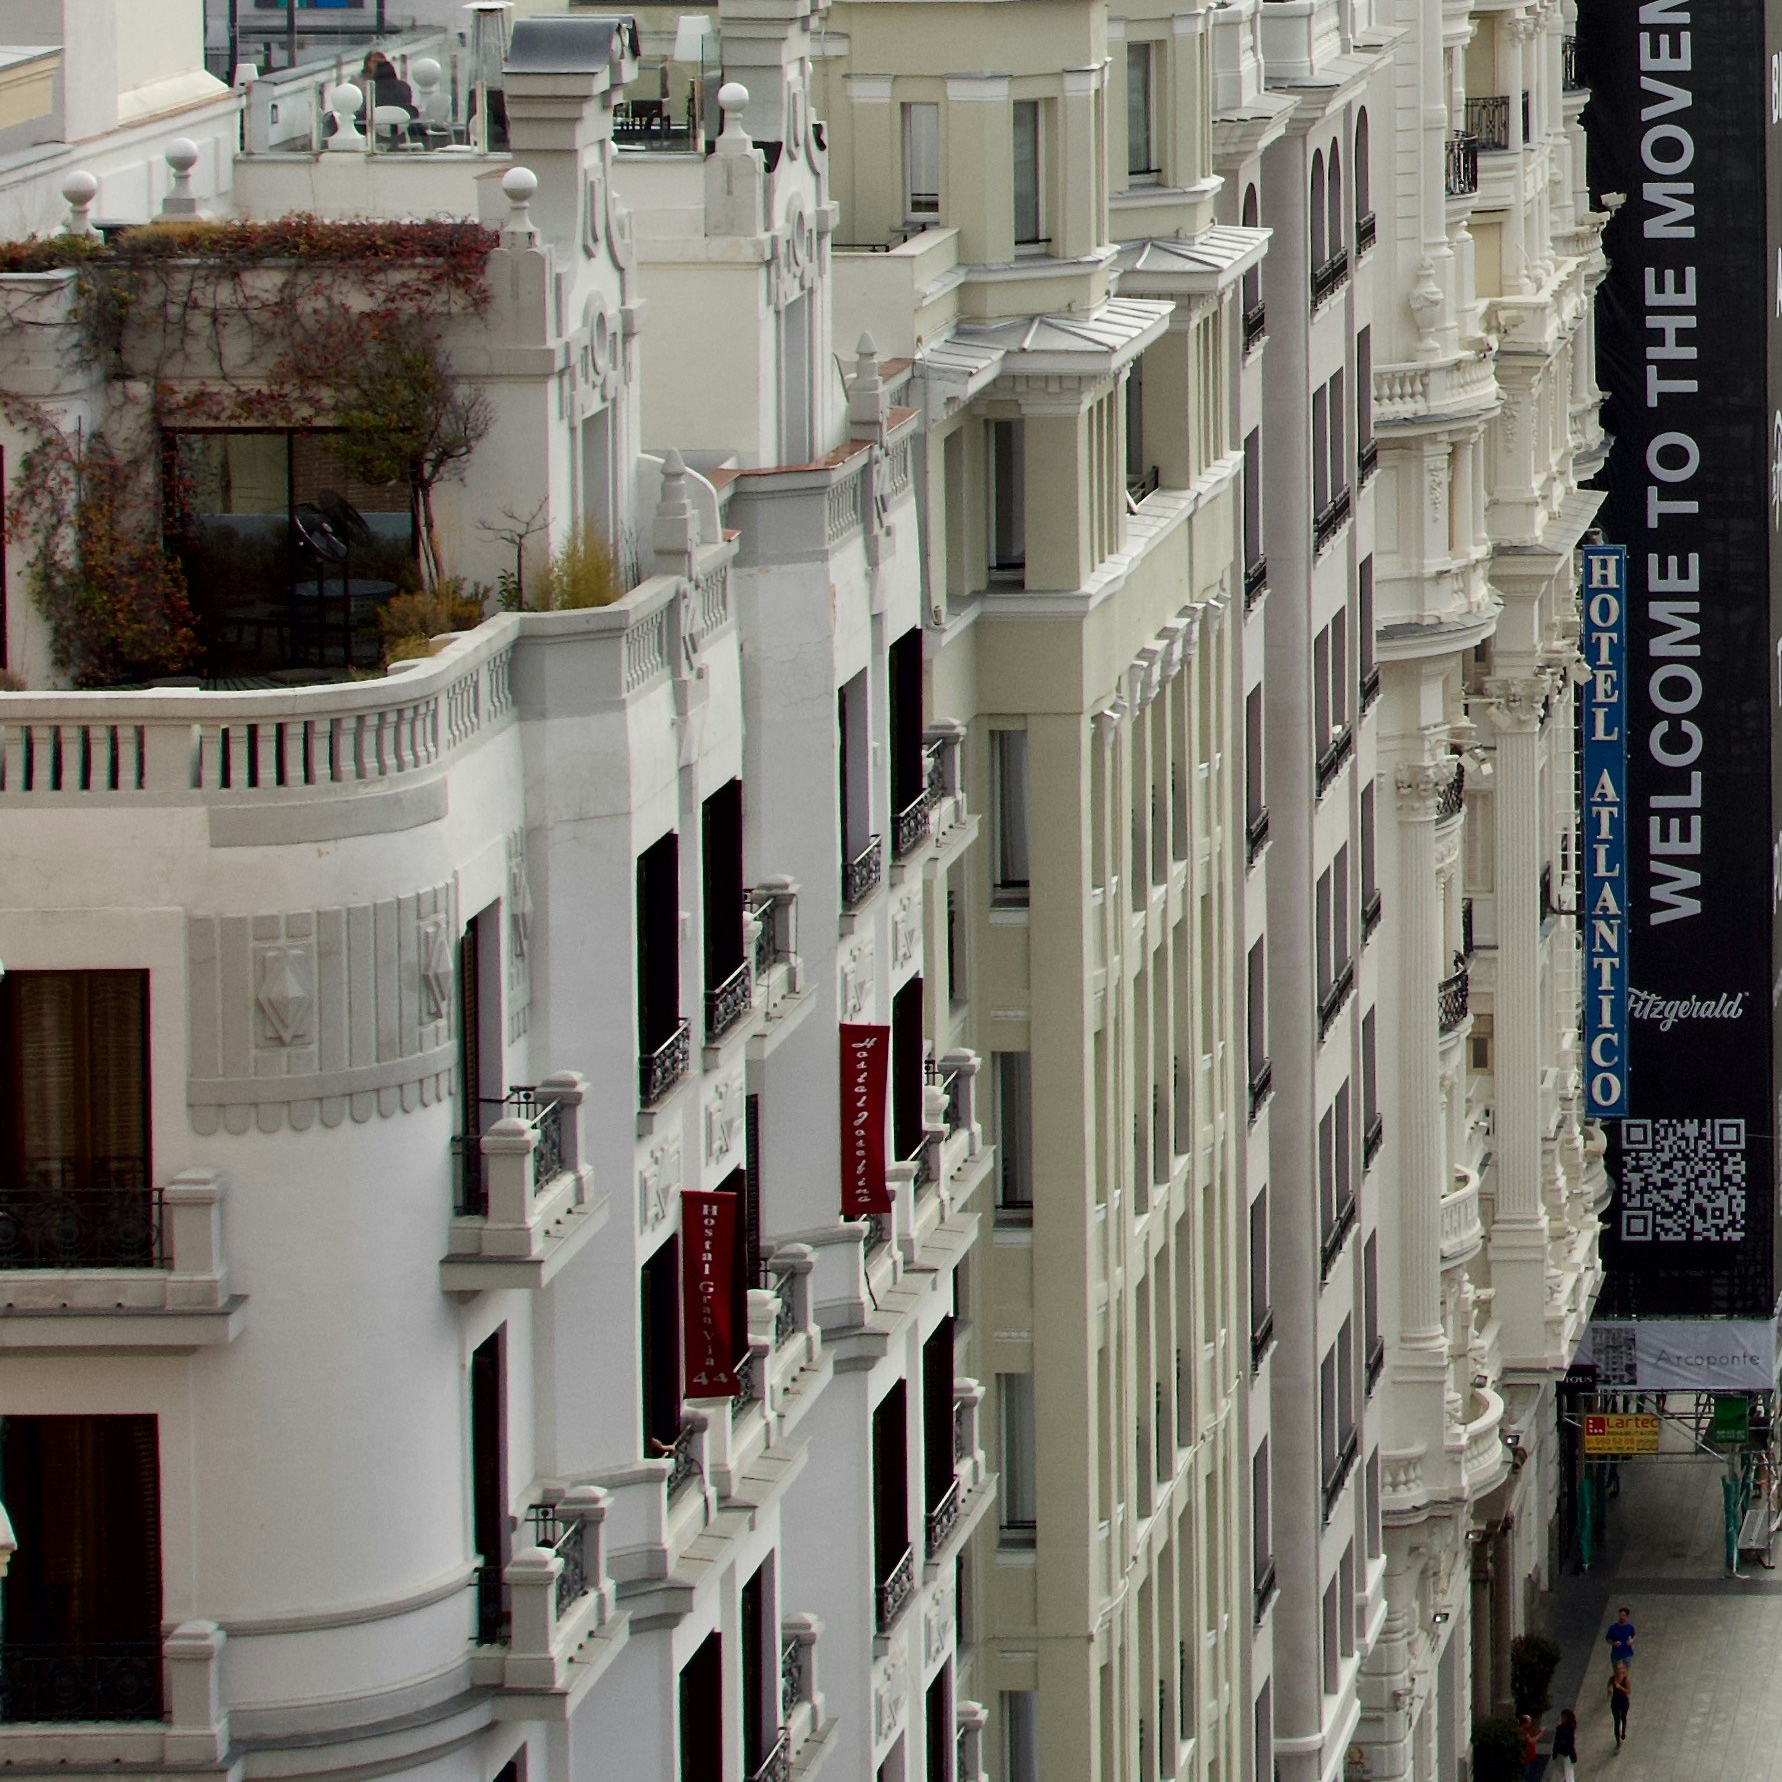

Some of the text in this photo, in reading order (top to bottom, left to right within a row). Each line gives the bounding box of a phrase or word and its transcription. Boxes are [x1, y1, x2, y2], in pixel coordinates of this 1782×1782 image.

[1645, 266, 1698, 407] THE
[1646, 431, 1699, 528] TO
[1649, 553, 1702, 925] WELCOME
[1589, 555, 1622, 1106] HOTEL ATLANTICO
[1628, 987, 1744, 1032] Fitzgerald
[851, 1037, 877, 1107] Hostal
[701, 1204, 718, 1275] Hostal
[699, 1281, 715, 1325] Gran
[692, 1371, 729, 1386] 44
[1655, 1349, 1761, 1368] Arcoponte
[1606, 1416, 1659, 1429] Lartec
